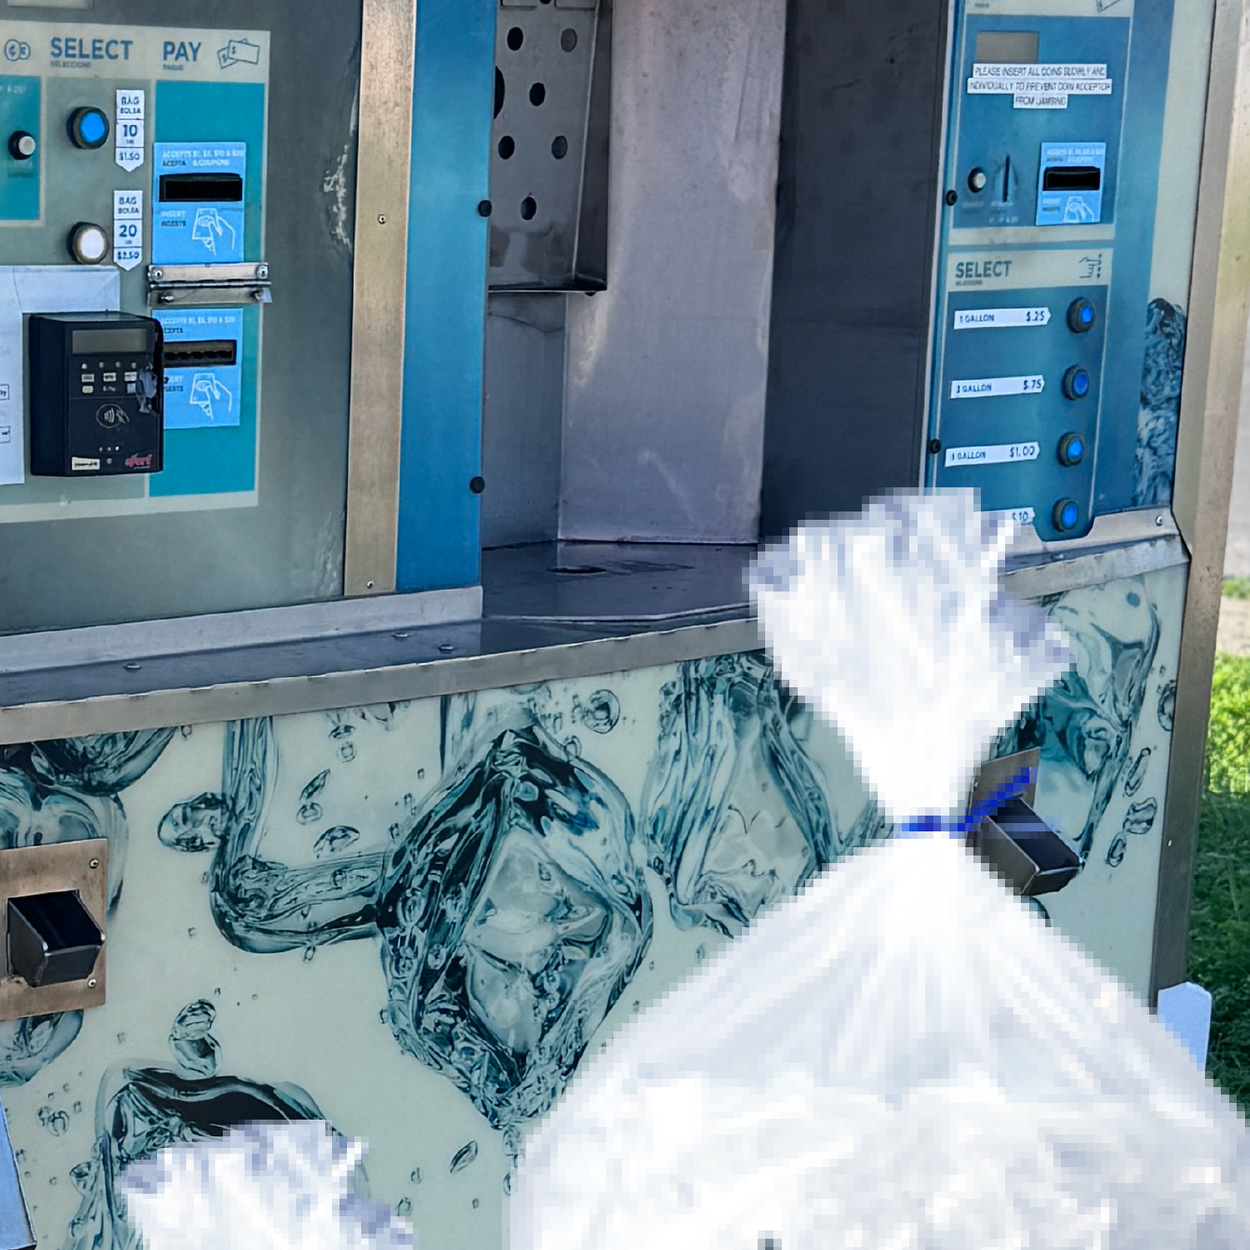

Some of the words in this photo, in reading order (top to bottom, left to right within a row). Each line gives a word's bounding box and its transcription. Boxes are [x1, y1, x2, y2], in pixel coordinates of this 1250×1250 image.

[50, 36, 134, 60] SELECT
[162, 40, 202, 62] PAY
[1002, 67, 1027, 76] INSERT
[1028, 67, 1040, 76] ALL
[121, 96, 140, 106] BAG
[122, 123, 138, 138] 10
[119, 151, 140, 161] $1.50
[119, 196, 137, 205] BAG
[119, 224, 137, 238] 20
[117, 249, 140, 261] $2.50
[955, 260, 1012, 279] SELECT
[959, 315, 963, 323] 1
[965, 314, 995, 323] GALLON
[1025, 310, 1045, 322] $.25
[962, 383, 992, 392] GALLON
[1023, 378, 1042, 390] $.75
[957, 451, 987, 459] GALLON
[1010, 445, 1036, 458] $1.00
